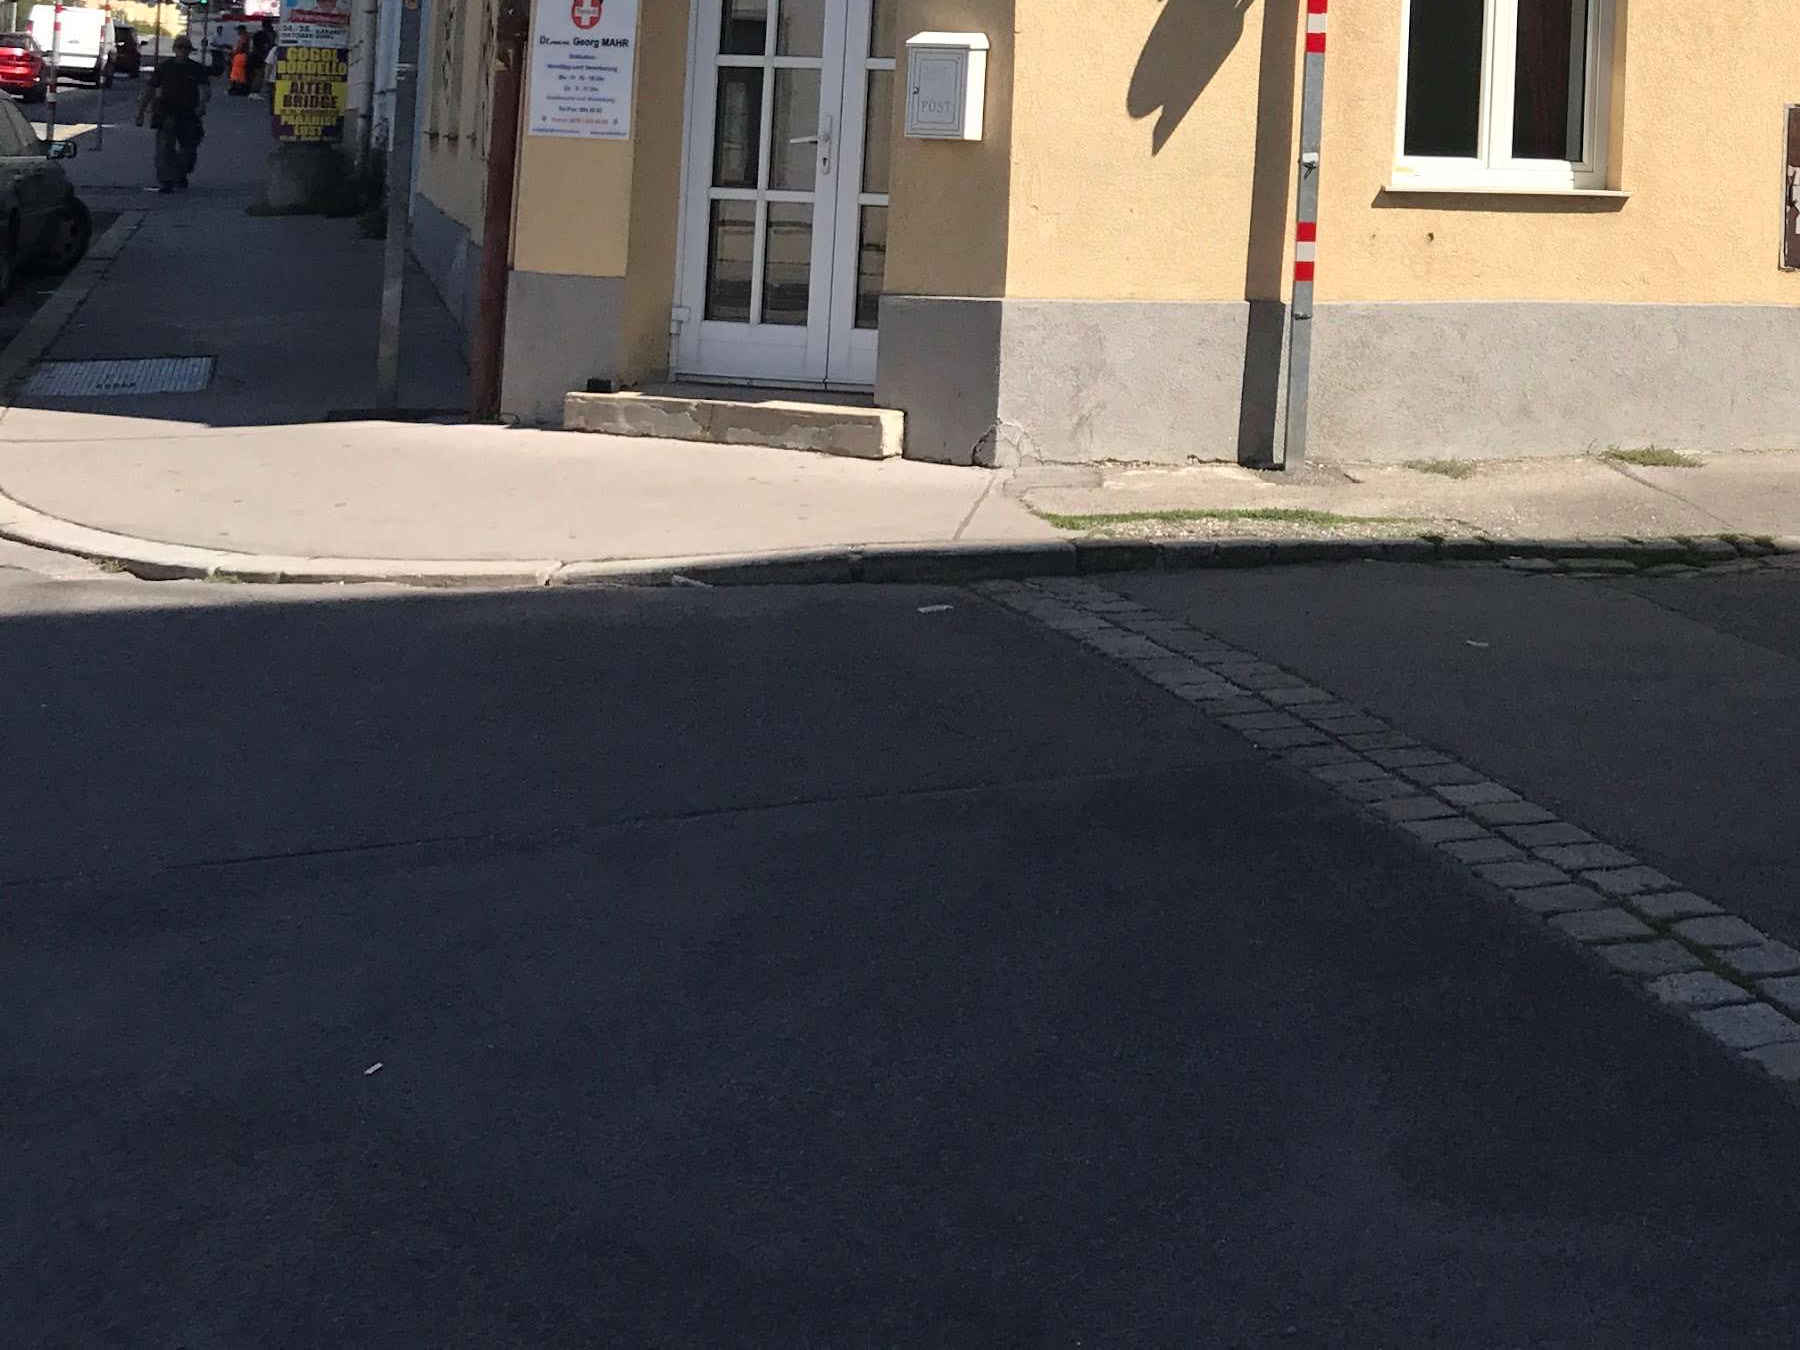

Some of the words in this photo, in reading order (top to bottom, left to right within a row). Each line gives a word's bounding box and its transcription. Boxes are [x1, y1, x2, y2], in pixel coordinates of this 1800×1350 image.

[573, 37, 599, 48] Georg
[601, 37, 629, 48] MAHR
[286, 47, 338, 61] GOGOL
[277, 60, 347, 75] BORDELLO
[290, 81, 333, 95] ALTER
[283, 94, 338, 109] BRIDGE
[922, 100, 952, 114] POST
